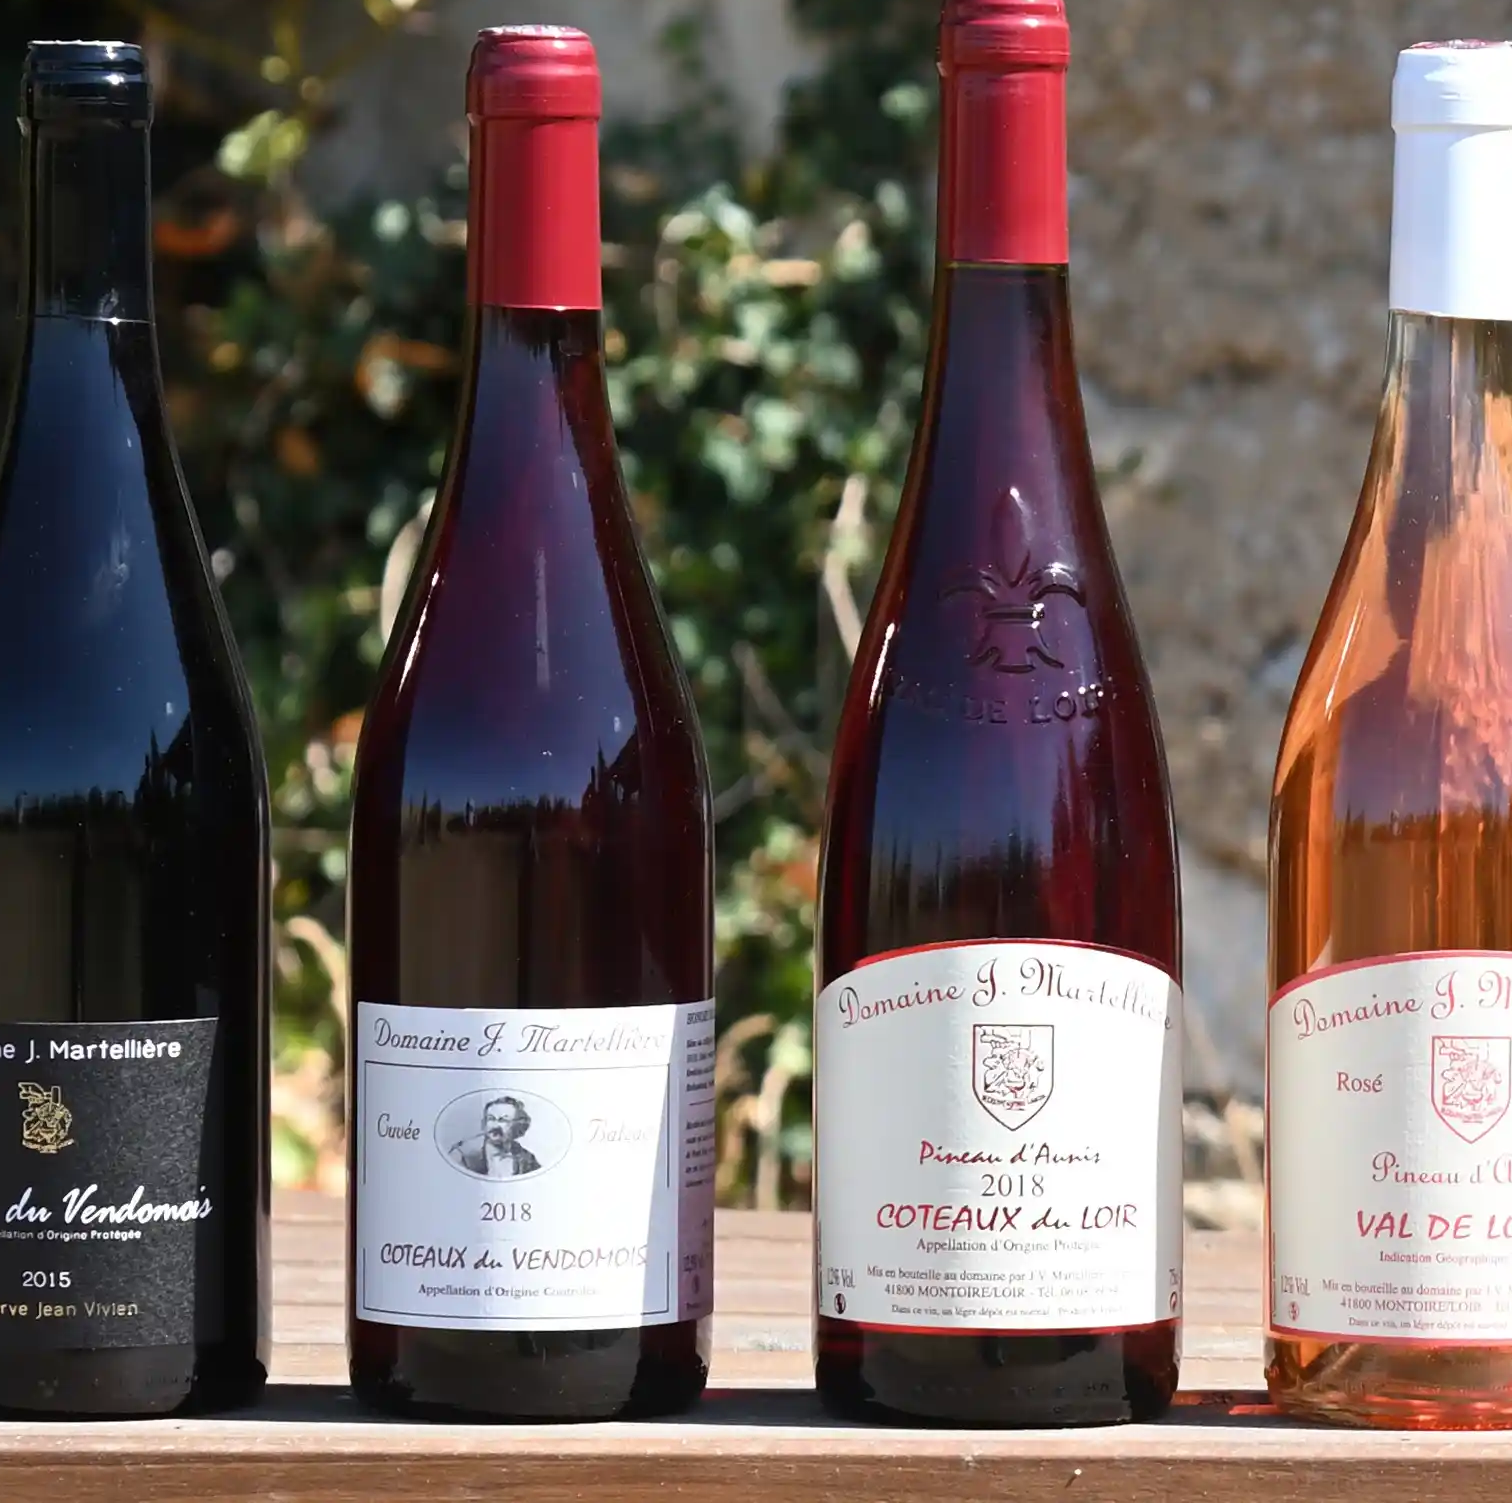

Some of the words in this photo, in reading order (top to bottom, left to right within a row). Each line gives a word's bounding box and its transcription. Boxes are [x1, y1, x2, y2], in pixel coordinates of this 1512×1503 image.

[839, 982, 965, 1029] Domaine
[973, 958, 1007, 1007] J.
[1020, 957, 1172, 1030] Martellièe
[1293, 995, 1423, 1041] Domaine
[1431, 970, 1465, 1020] J.
[374, 1018, 470, 1052] Domaine
[479, 1022, 506, 1056] J.
[26, 1041, 40, 1063] J.
[50, 1039, 181, 1060] Martellière
[1337, 1071, 1383, 1093] Rosé
[378, 1113, 420, 1140] Cuvée
[919, 1141, 1002, 1166] Pineau
[1011, 1142, 1100, 1165] d'Aunis
[1372, 1151, 1461, 1184] Pineau
[981, 1173, 1044, 1197] 2018
[6, 1187, 51, 1224] du
[480, 1202, 532, 1222] 2018
[877, 1203, 1022, 1231] COTEAUX
[1032, 1207, 1071, 1229] du
[1081, 1204, 1137, 1230] LOIR
[1357, 1209, 1413, 1239] VAL
[1428, 1214, 1472, 1240] DE
[381, 1243, 466, 1269] COTEAUX
[474, 1252, 502, 1270] du
[512, 1245, 648, 1271] VENDOMOIS
[916, 1238, 986, 1253] Appellation
[991, 1237, 1050, 1253] d'Origine
[1379, 1251, 1432, 1264] Indication
[22, 1271, 71, 1287] 2015
[867, 1266, 883, 1277] Mis
[884, 1270, 896, 1278] en
[898, 1268, 941, 1281] bouteille
[944, 1271, 957, 1281] au
[961, 1270, 1005, 1282] domaine
[1008, 1272, 1026, 1283] par
[418, 1284, 480, 1298] Appellation
[485, 1285, 539, 1300] d'Origine
[884, 1284, 914, 1296] 41800
[36, 1302, 76, 1319] Jean
[84, 1302, 138, 1317] Vivien
